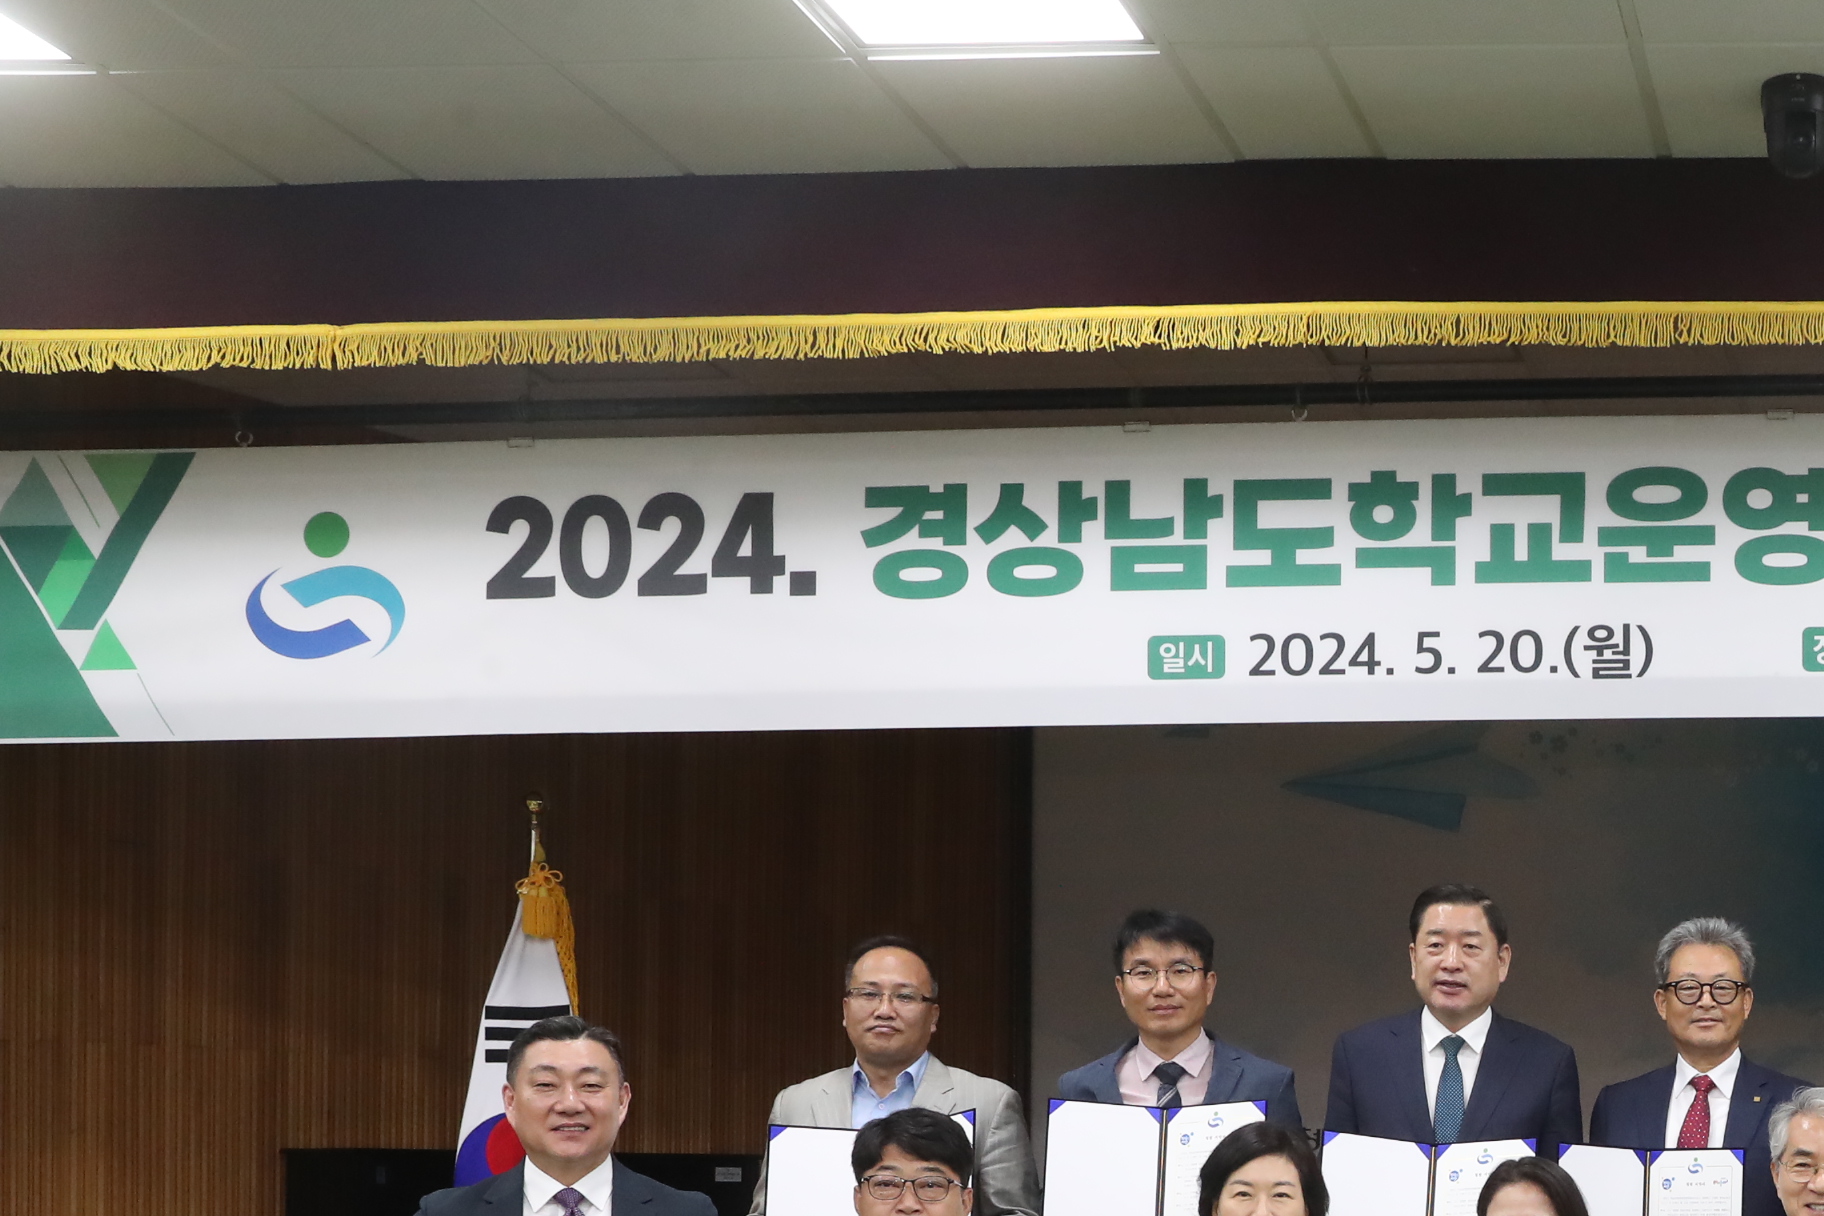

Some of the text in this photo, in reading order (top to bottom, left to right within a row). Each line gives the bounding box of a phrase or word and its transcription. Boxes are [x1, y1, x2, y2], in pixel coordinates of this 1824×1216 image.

[486, 491, 817, 600] 2024.
[1159, 622, 1655, 681] 일시 2024. 5. 20.(월)
